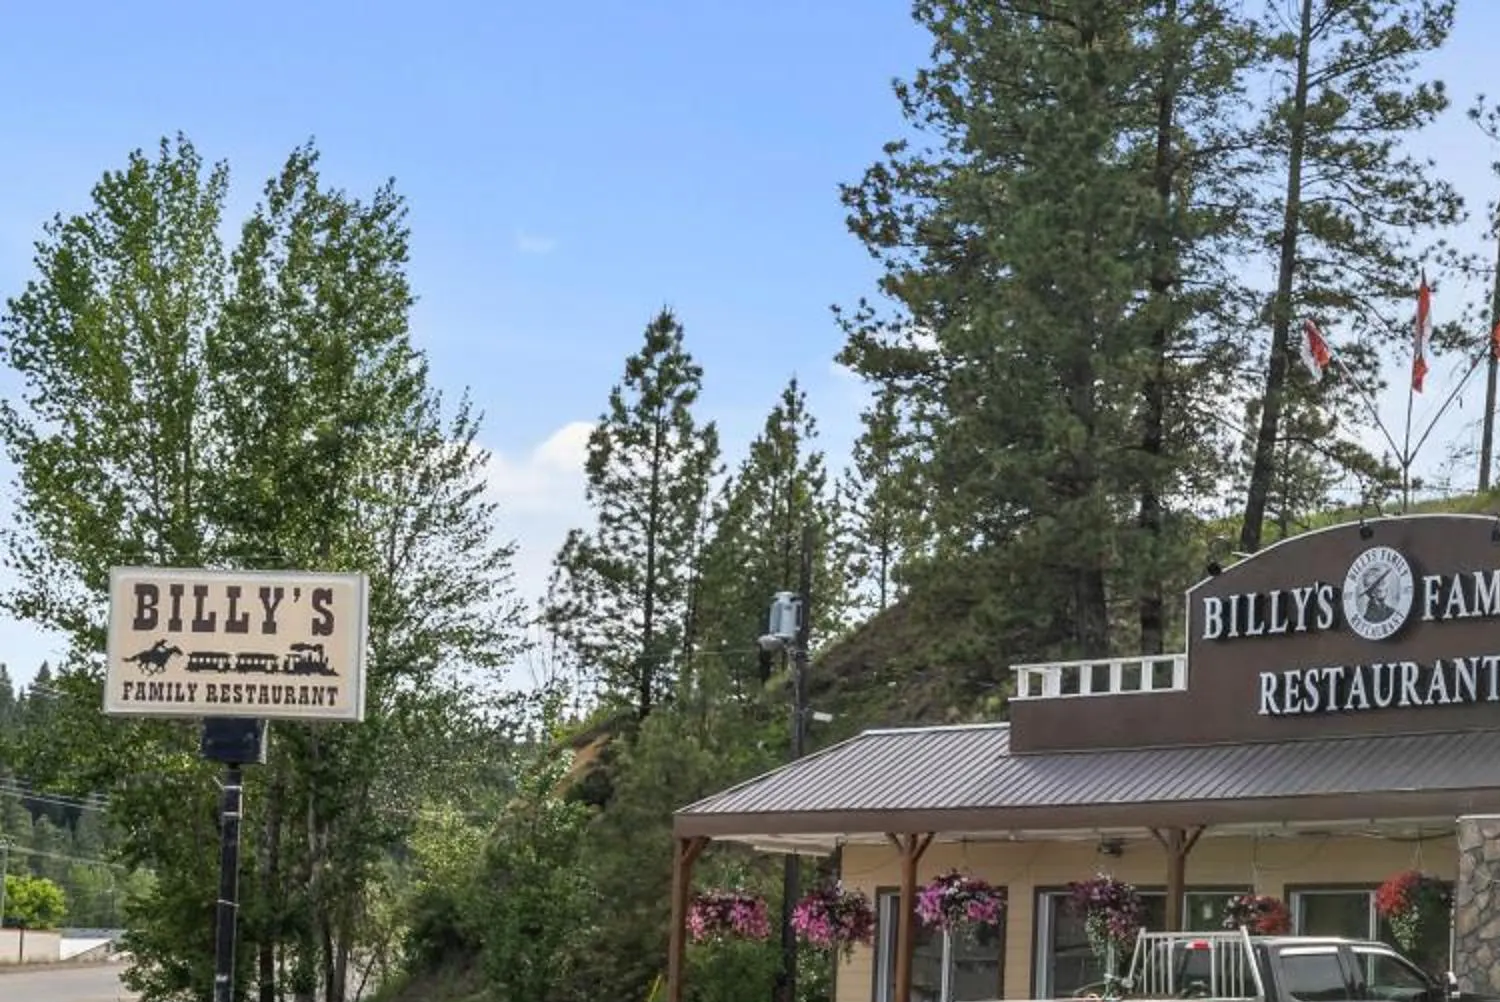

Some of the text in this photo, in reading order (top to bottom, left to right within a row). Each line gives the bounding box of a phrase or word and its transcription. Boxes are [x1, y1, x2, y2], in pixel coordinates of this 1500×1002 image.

[132, 583, 335, 637] BILLY'S
[1201, 580, 1334, 640] BILLY'S
[122, 680, 339, 707] FAMILY RESTAURANT
